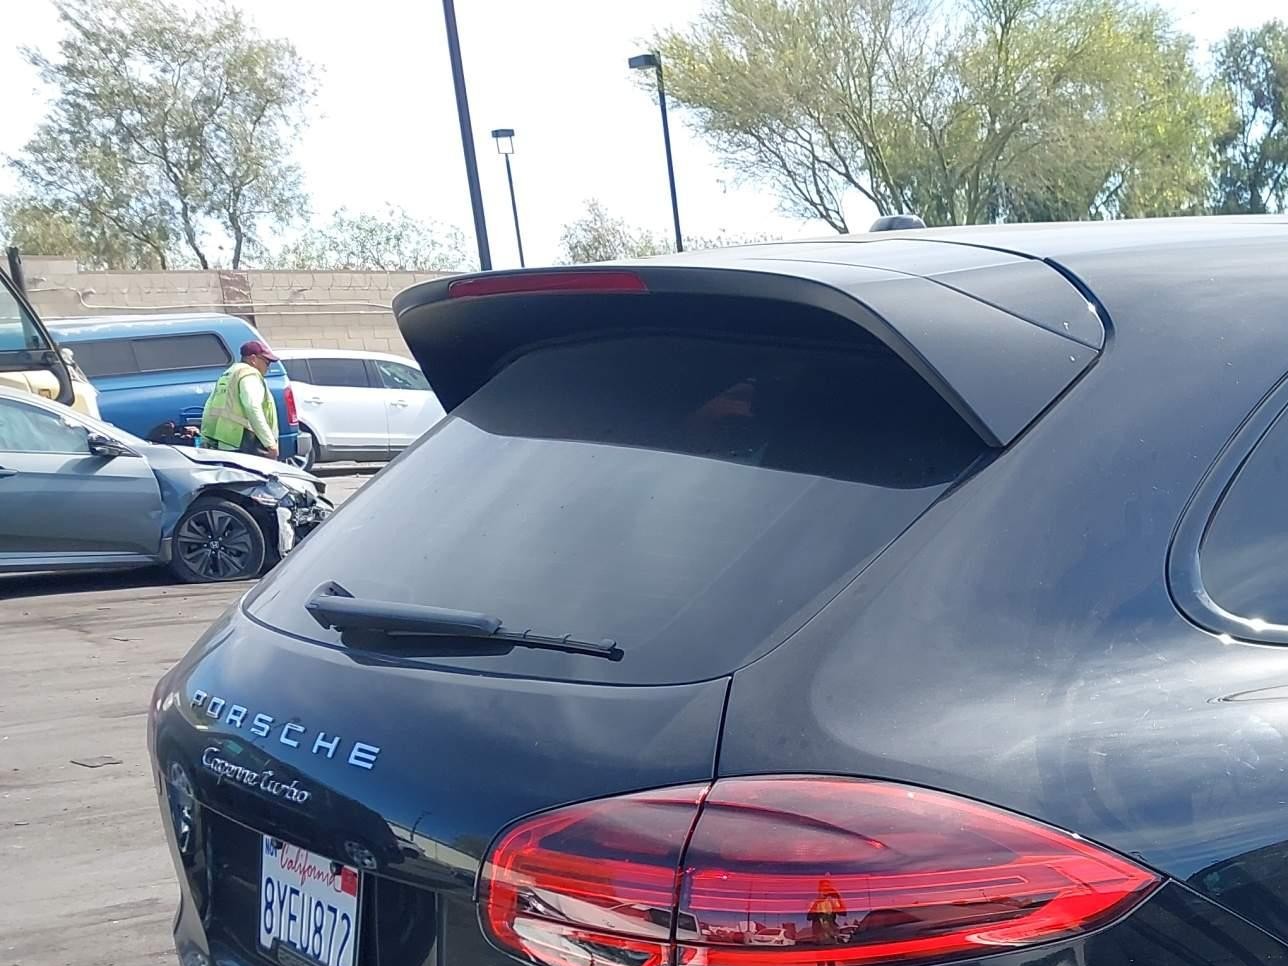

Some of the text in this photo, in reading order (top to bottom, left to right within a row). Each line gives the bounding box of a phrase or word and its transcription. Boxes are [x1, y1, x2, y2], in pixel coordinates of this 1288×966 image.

[190, 689, 381, 770] PORSCHE
[202, 746, 259, 785] Cayenne
[280, 840, 337, 887] California
